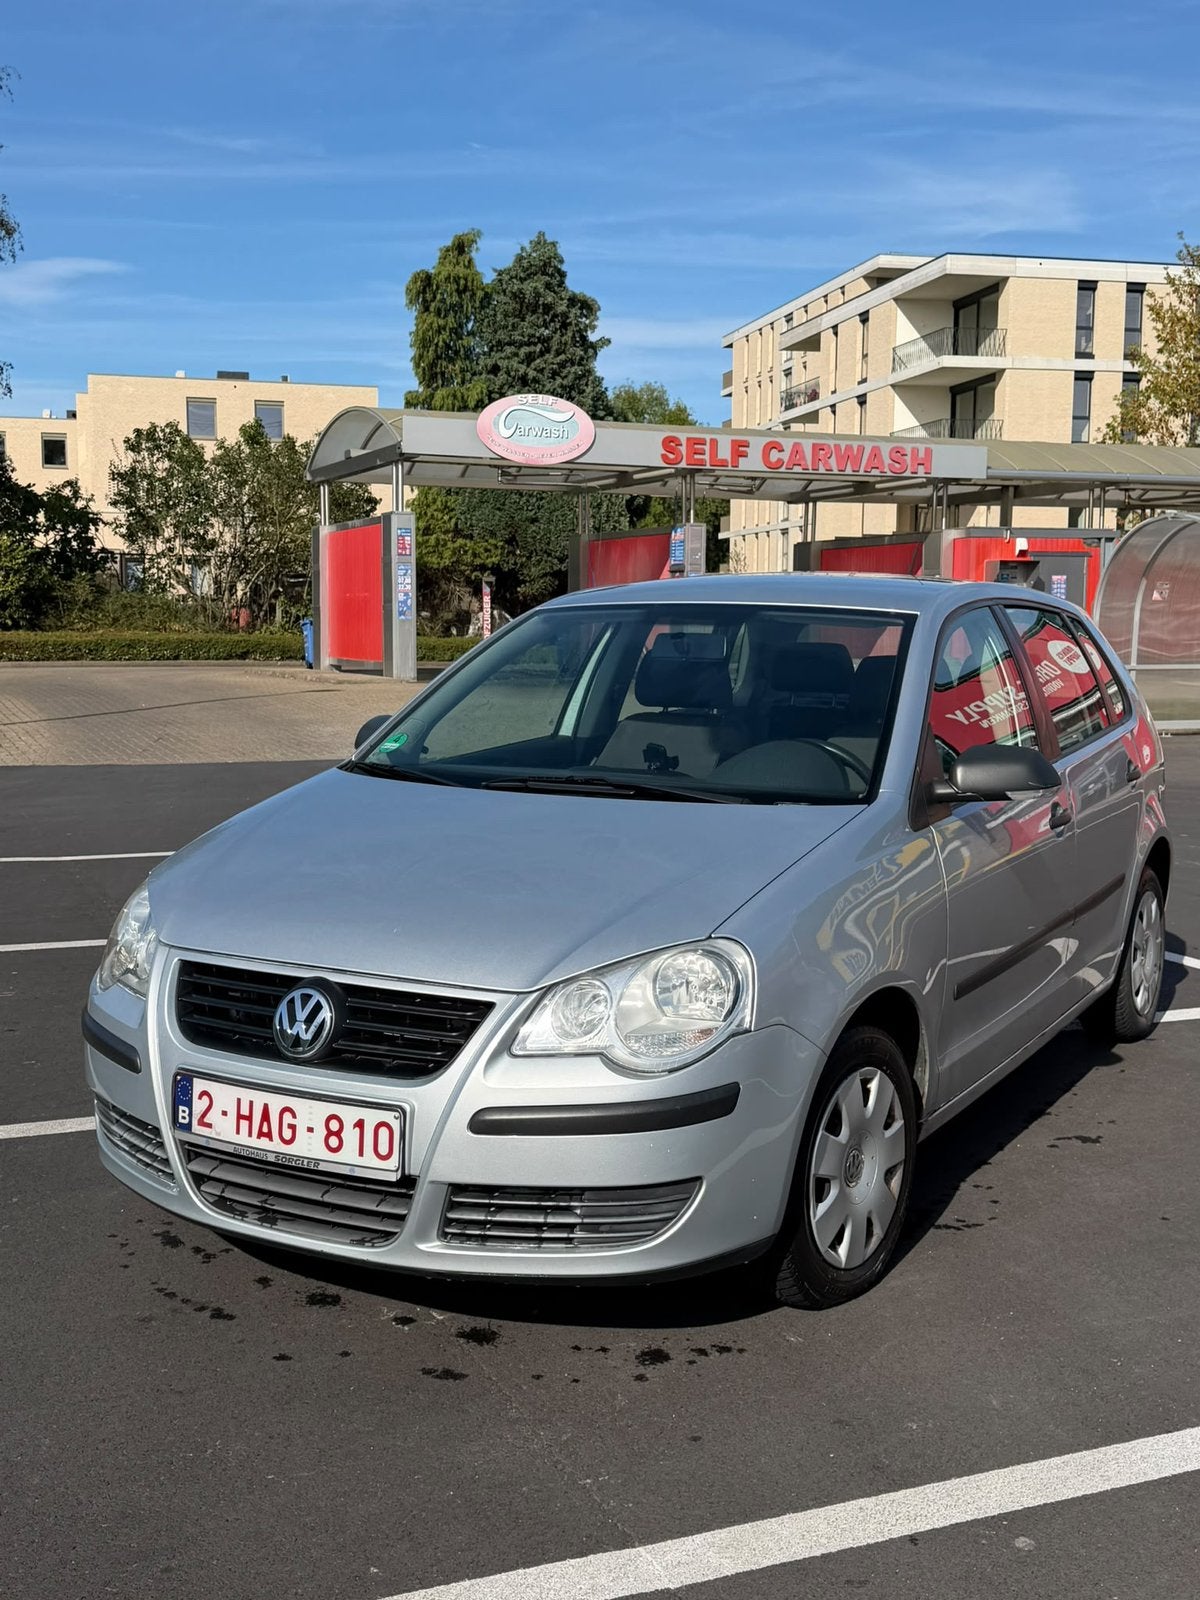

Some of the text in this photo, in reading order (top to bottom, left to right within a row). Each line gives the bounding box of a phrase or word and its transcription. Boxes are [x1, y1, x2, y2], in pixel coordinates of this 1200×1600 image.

[517, 394, 558, 407] SELF
[661, 435, 933, 475] SELF CARWASH
[177, 1105, 190, 1124] B
[196, 1089, 395, 1162] 2-HAG-810
[232, 1146, 321, 1169] AUTOHAUS SORGLER
